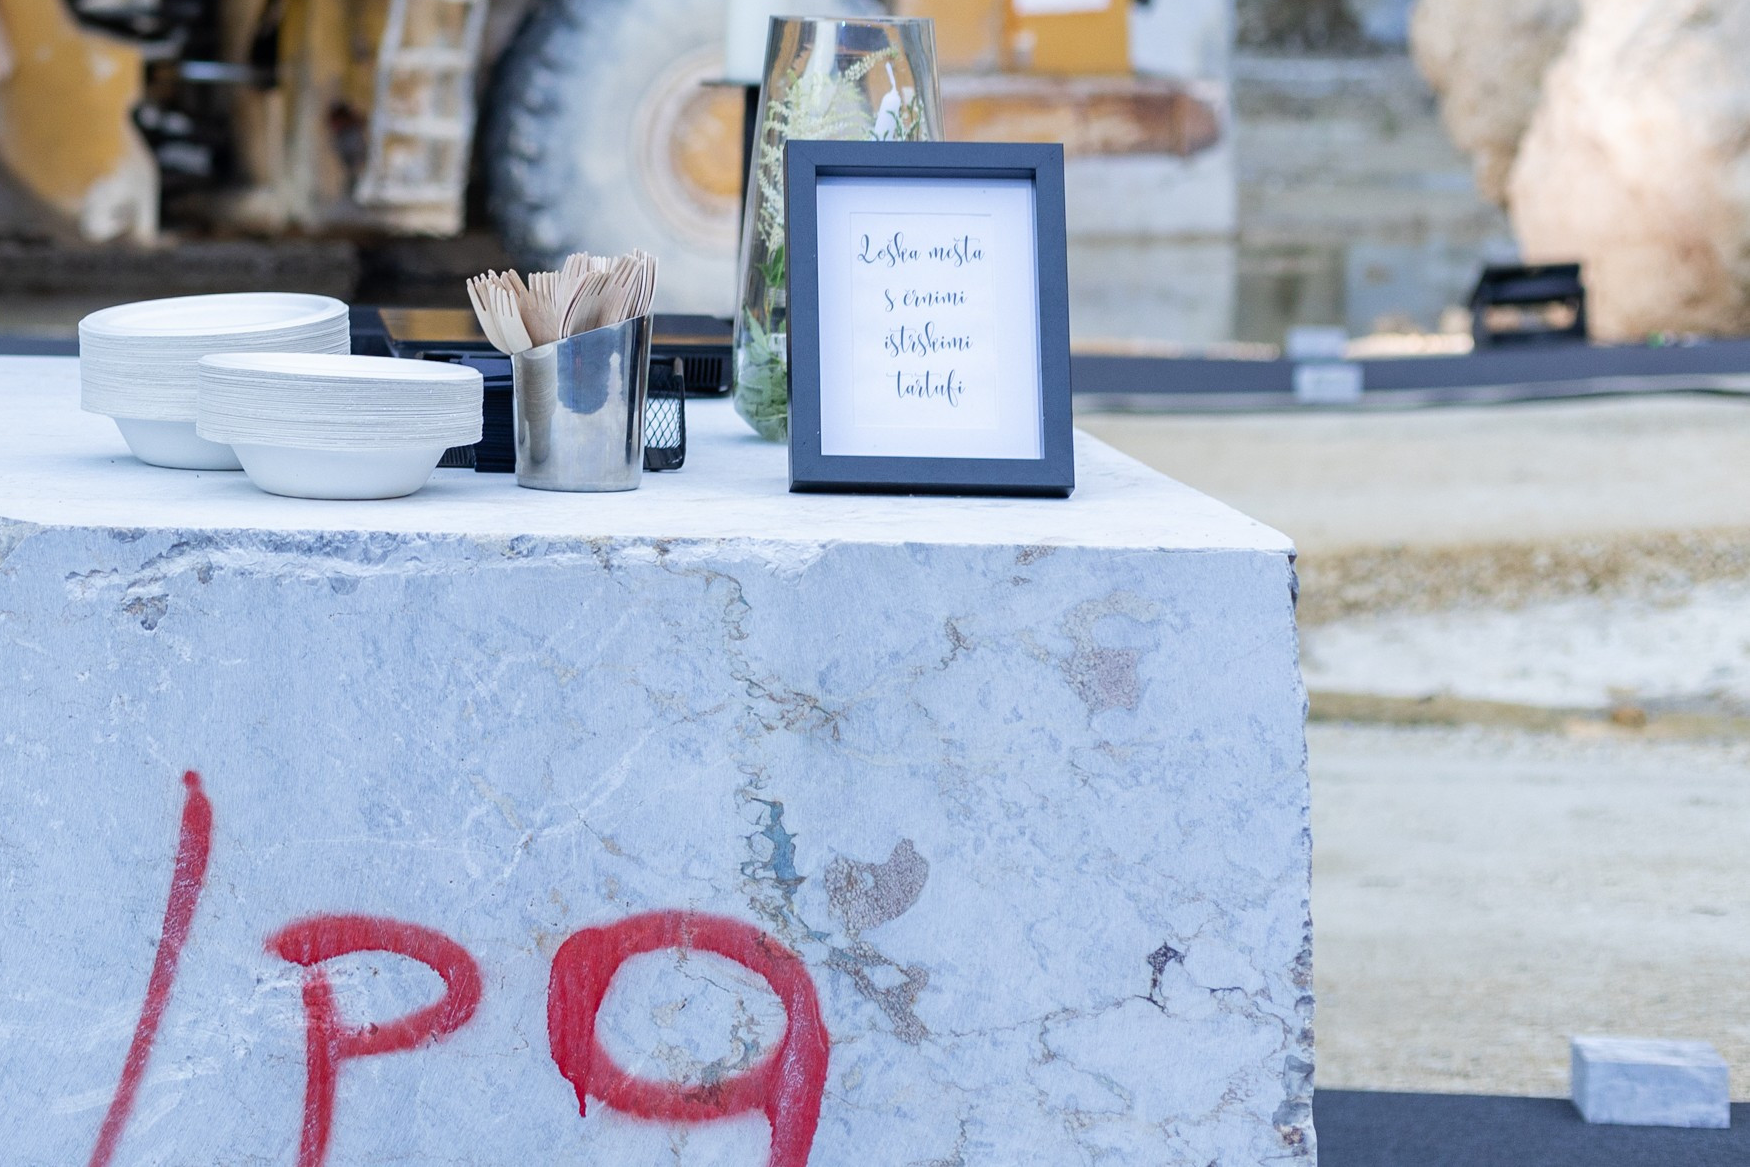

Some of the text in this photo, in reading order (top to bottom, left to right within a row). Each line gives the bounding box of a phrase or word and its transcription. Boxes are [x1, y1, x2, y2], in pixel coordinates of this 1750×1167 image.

[857, 231, 985, 268] Loška mešta
[903, 289, 968, 307] črnimi
[885, 320, 973, 358] istrskimi
[886, 369, 966, 407] tartufi
